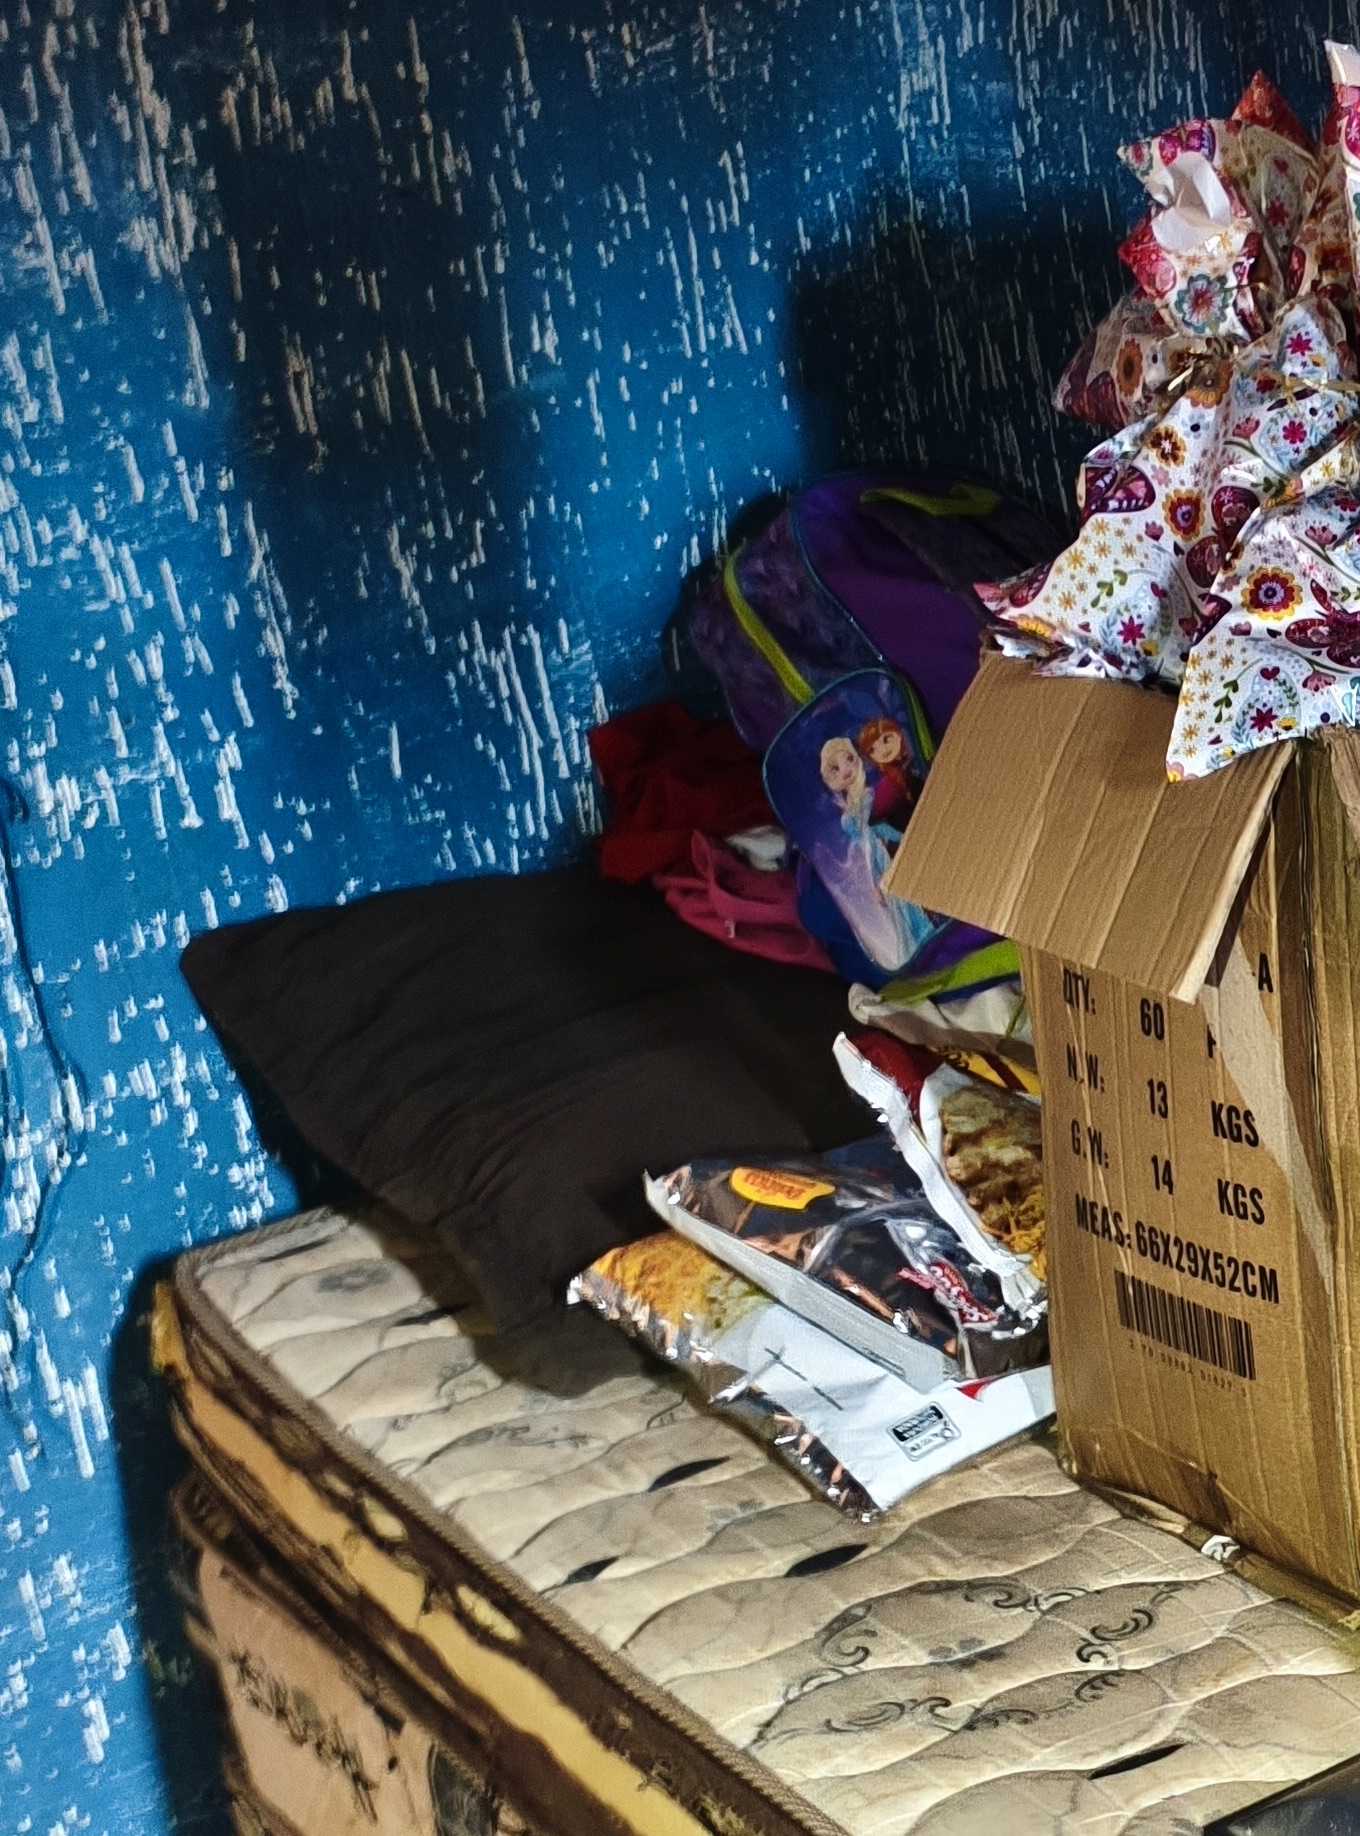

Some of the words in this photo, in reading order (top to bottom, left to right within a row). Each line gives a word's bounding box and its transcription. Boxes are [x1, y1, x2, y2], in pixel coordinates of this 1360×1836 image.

[1140, 997, 1165, 1041] 60
[1147, 1077, 1169, 1120] 13
[1211, 1100, 1260, 1148] KGS
[1151, 1154, 1174, 1196] 14
[1217, 1177, 1266, 1226] KGS
